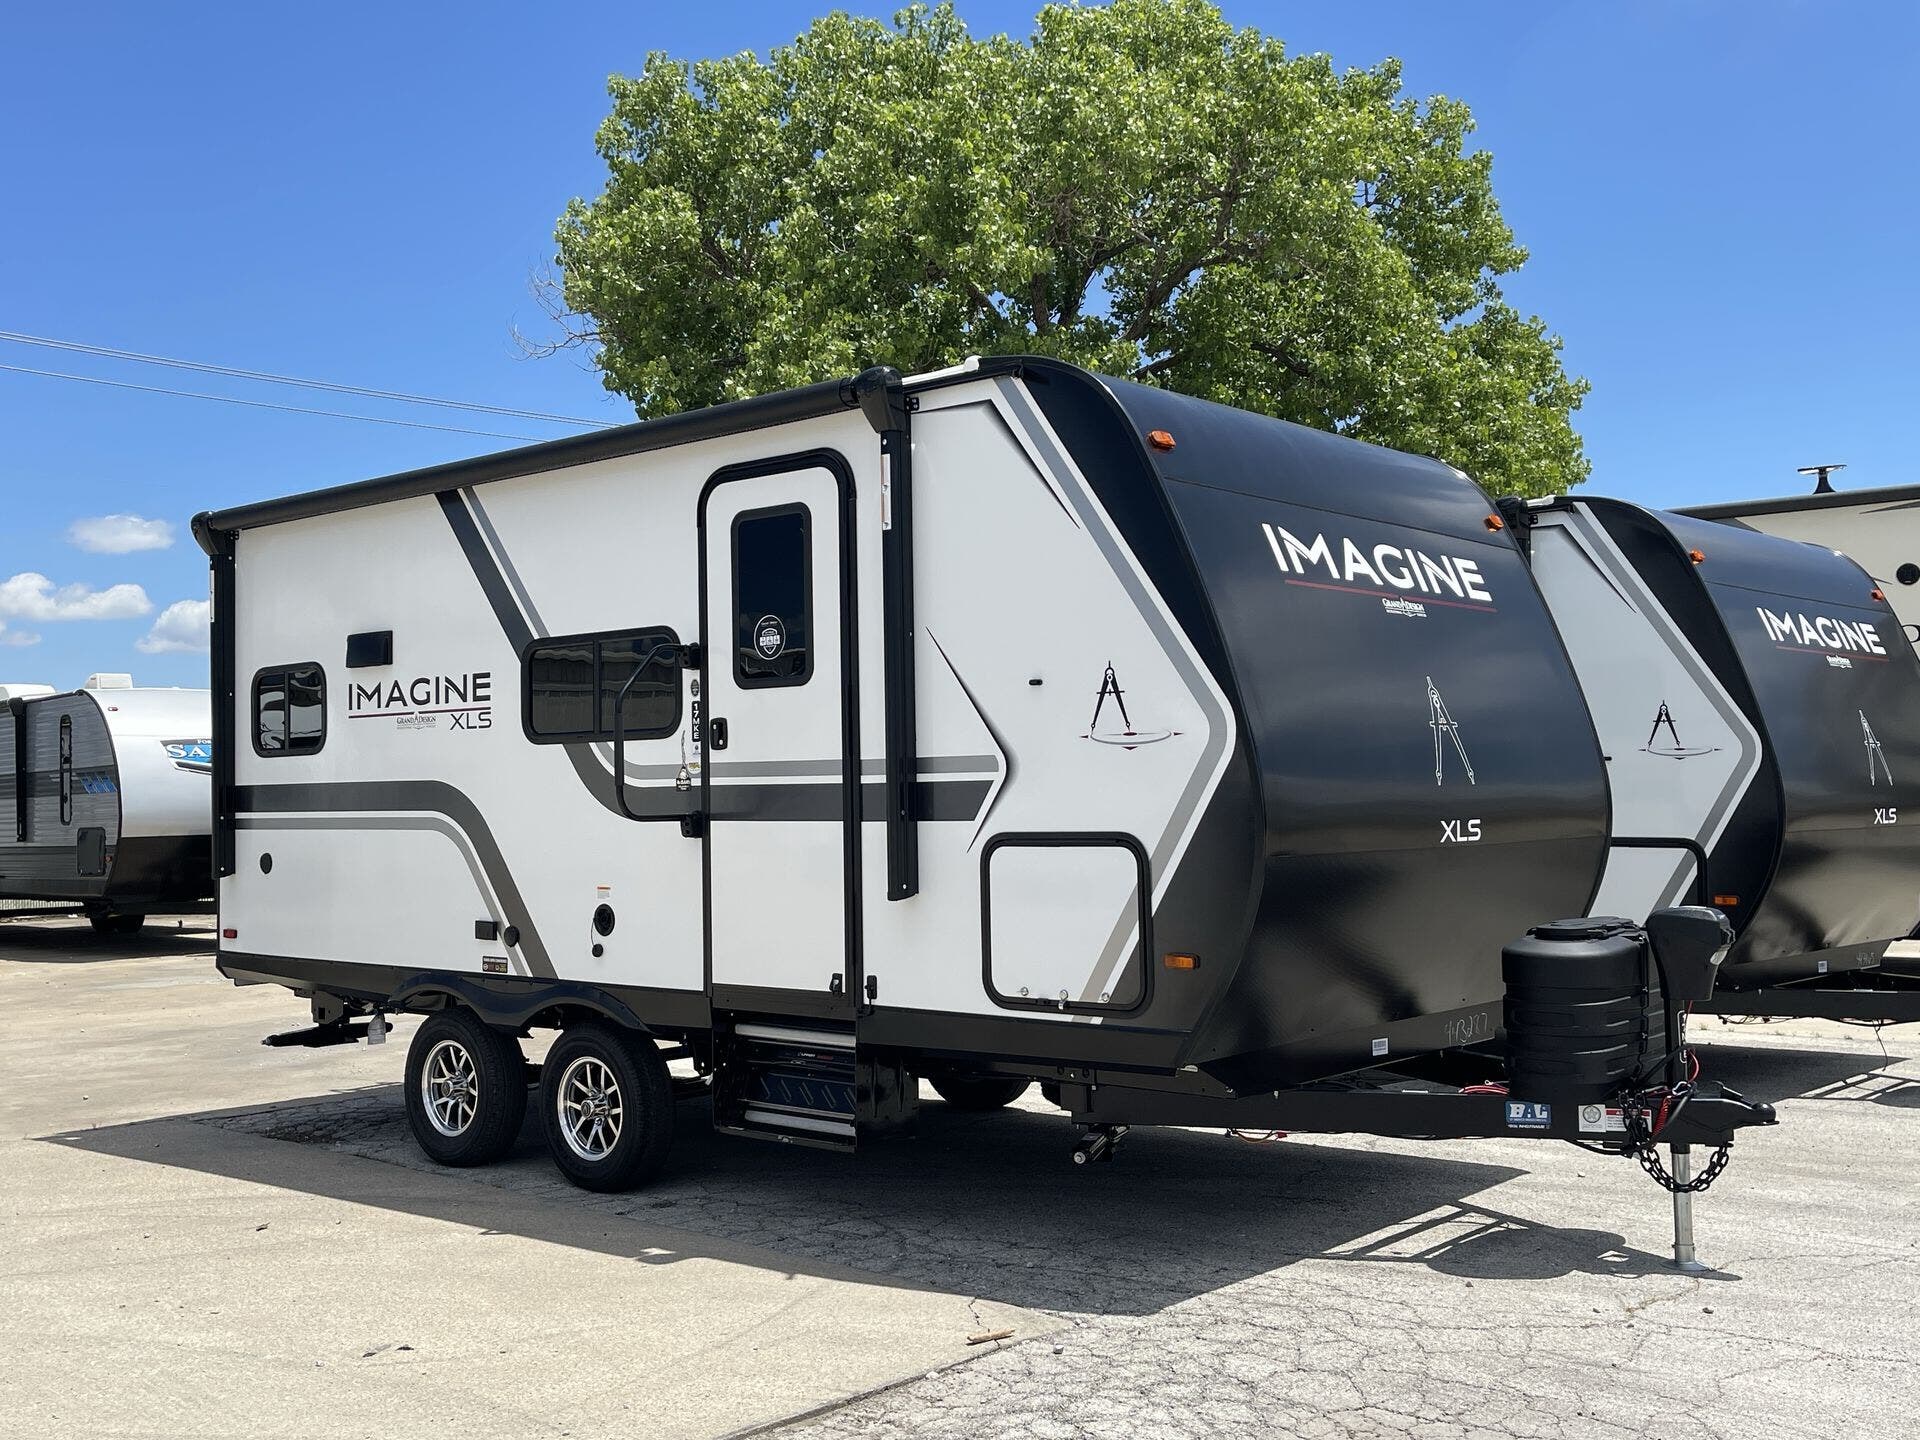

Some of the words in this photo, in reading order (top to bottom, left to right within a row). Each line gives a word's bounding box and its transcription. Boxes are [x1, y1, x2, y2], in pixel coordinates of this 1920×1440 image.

[1261, 522, 1493, 602] IMAGINE
[1756, 606, 1887, 655] IMAGINE
[348, 672, 491, 711] IMAGINE
[450, 711, 492, 730] XLS
[166, 744, 212, 758] SA
[1874, 807, 1897, 825] XLS
[1439, 818, 1482, 843] XLS
[1509, 1103, 1548, 1119] BAL
